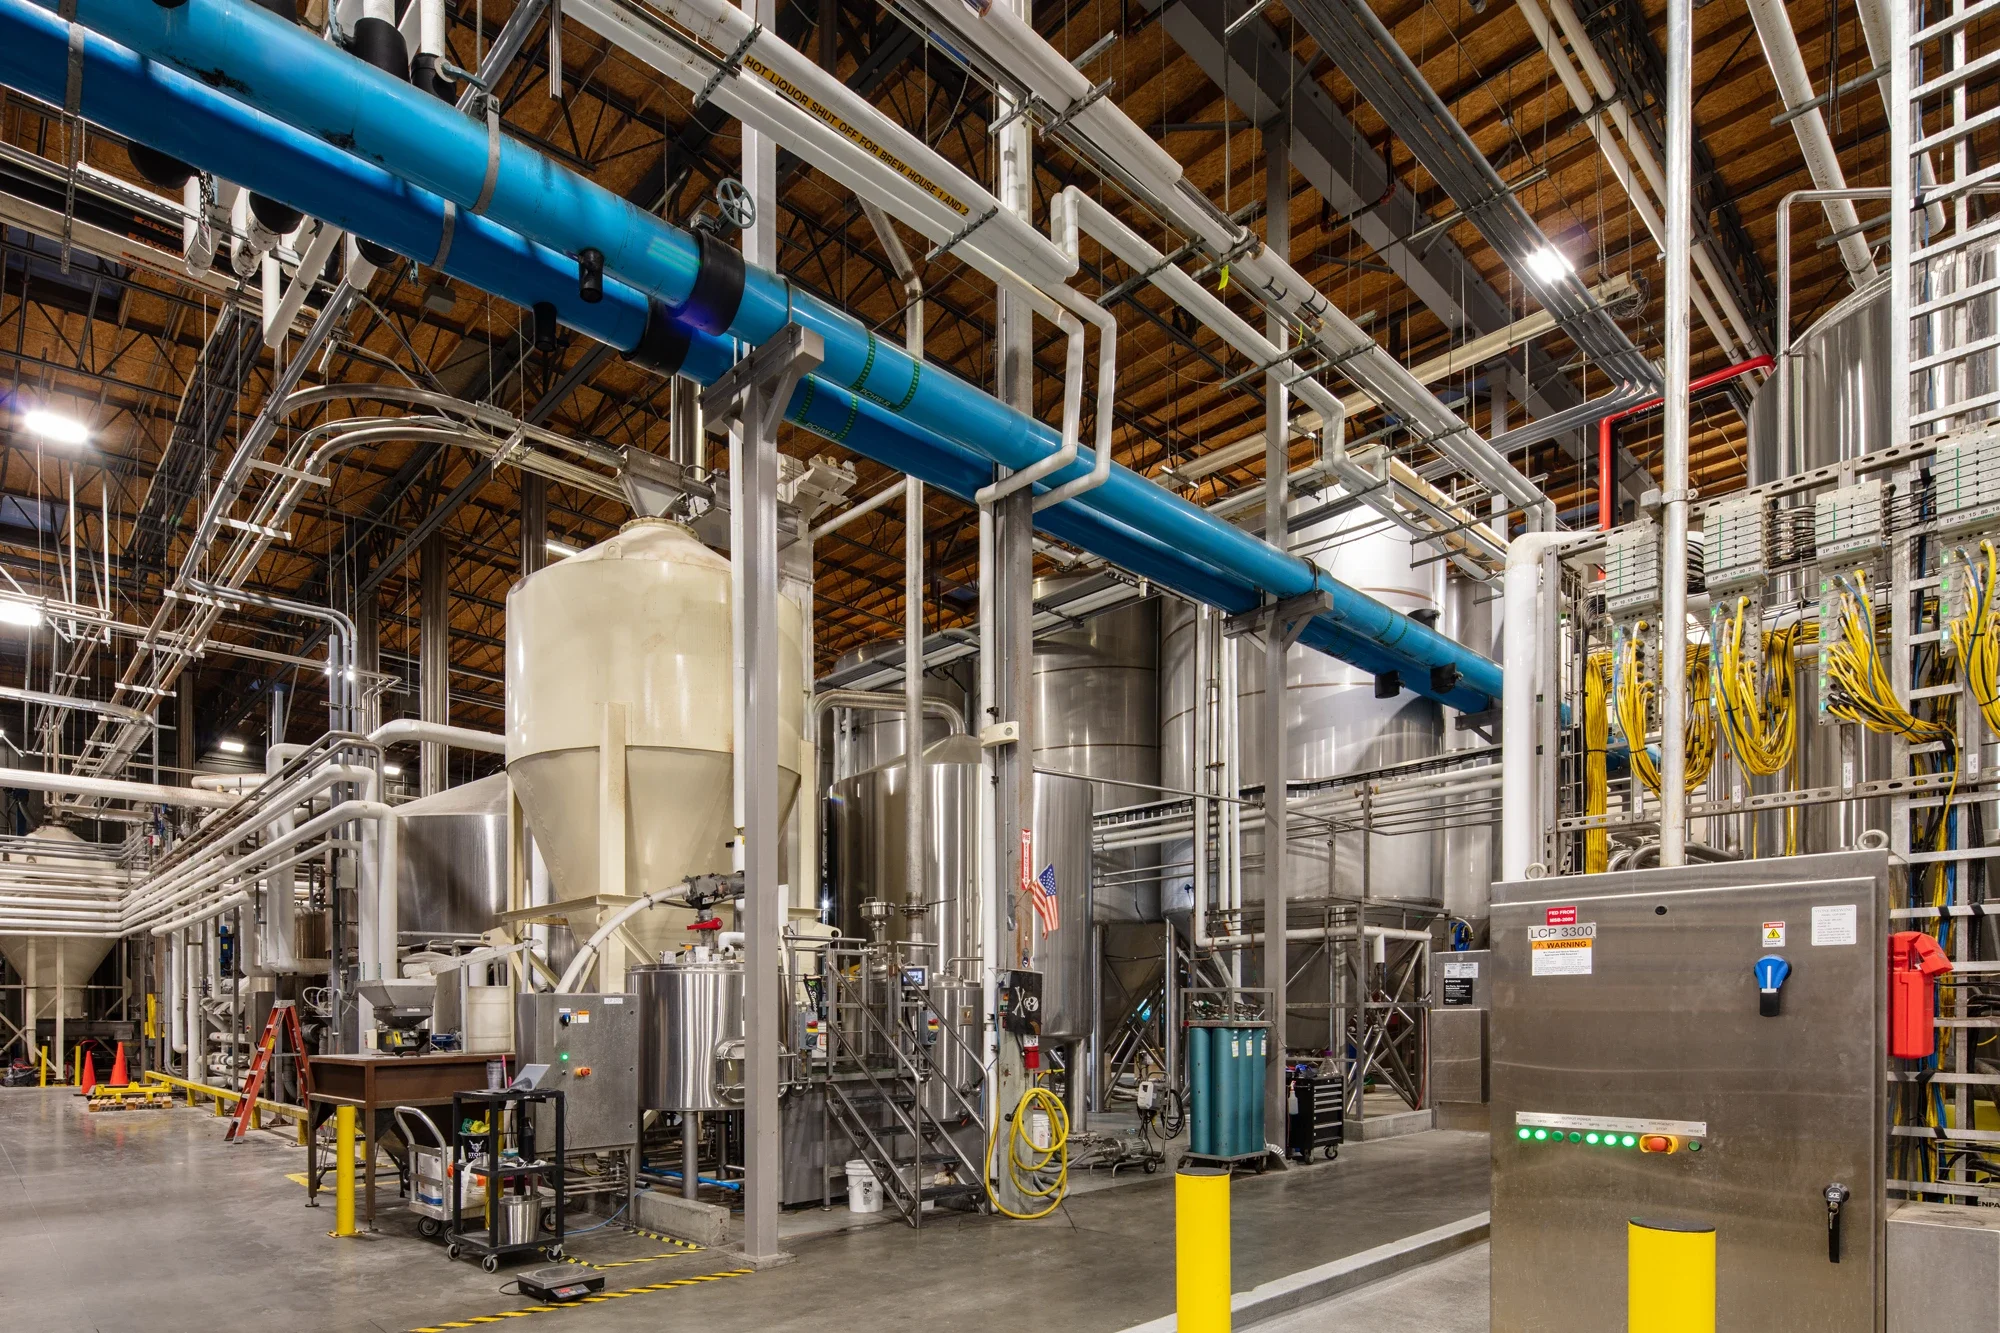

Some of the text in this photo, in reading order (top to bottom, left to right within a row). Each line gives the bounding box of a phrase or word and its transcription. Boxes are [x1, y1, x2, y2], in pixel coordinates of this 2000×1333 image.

[744, 55, 969, 216] HOT LIQUOR SHUT OFF FOR BREW HOUSE 1 AND 2
[860, 388, 890, 406] PCHW-R
[806, 422, 837, 438] PCHW-S
[1531, 926, 1593, 938] LCP 3300
[1547, 941, 1587, 949] WARNING
